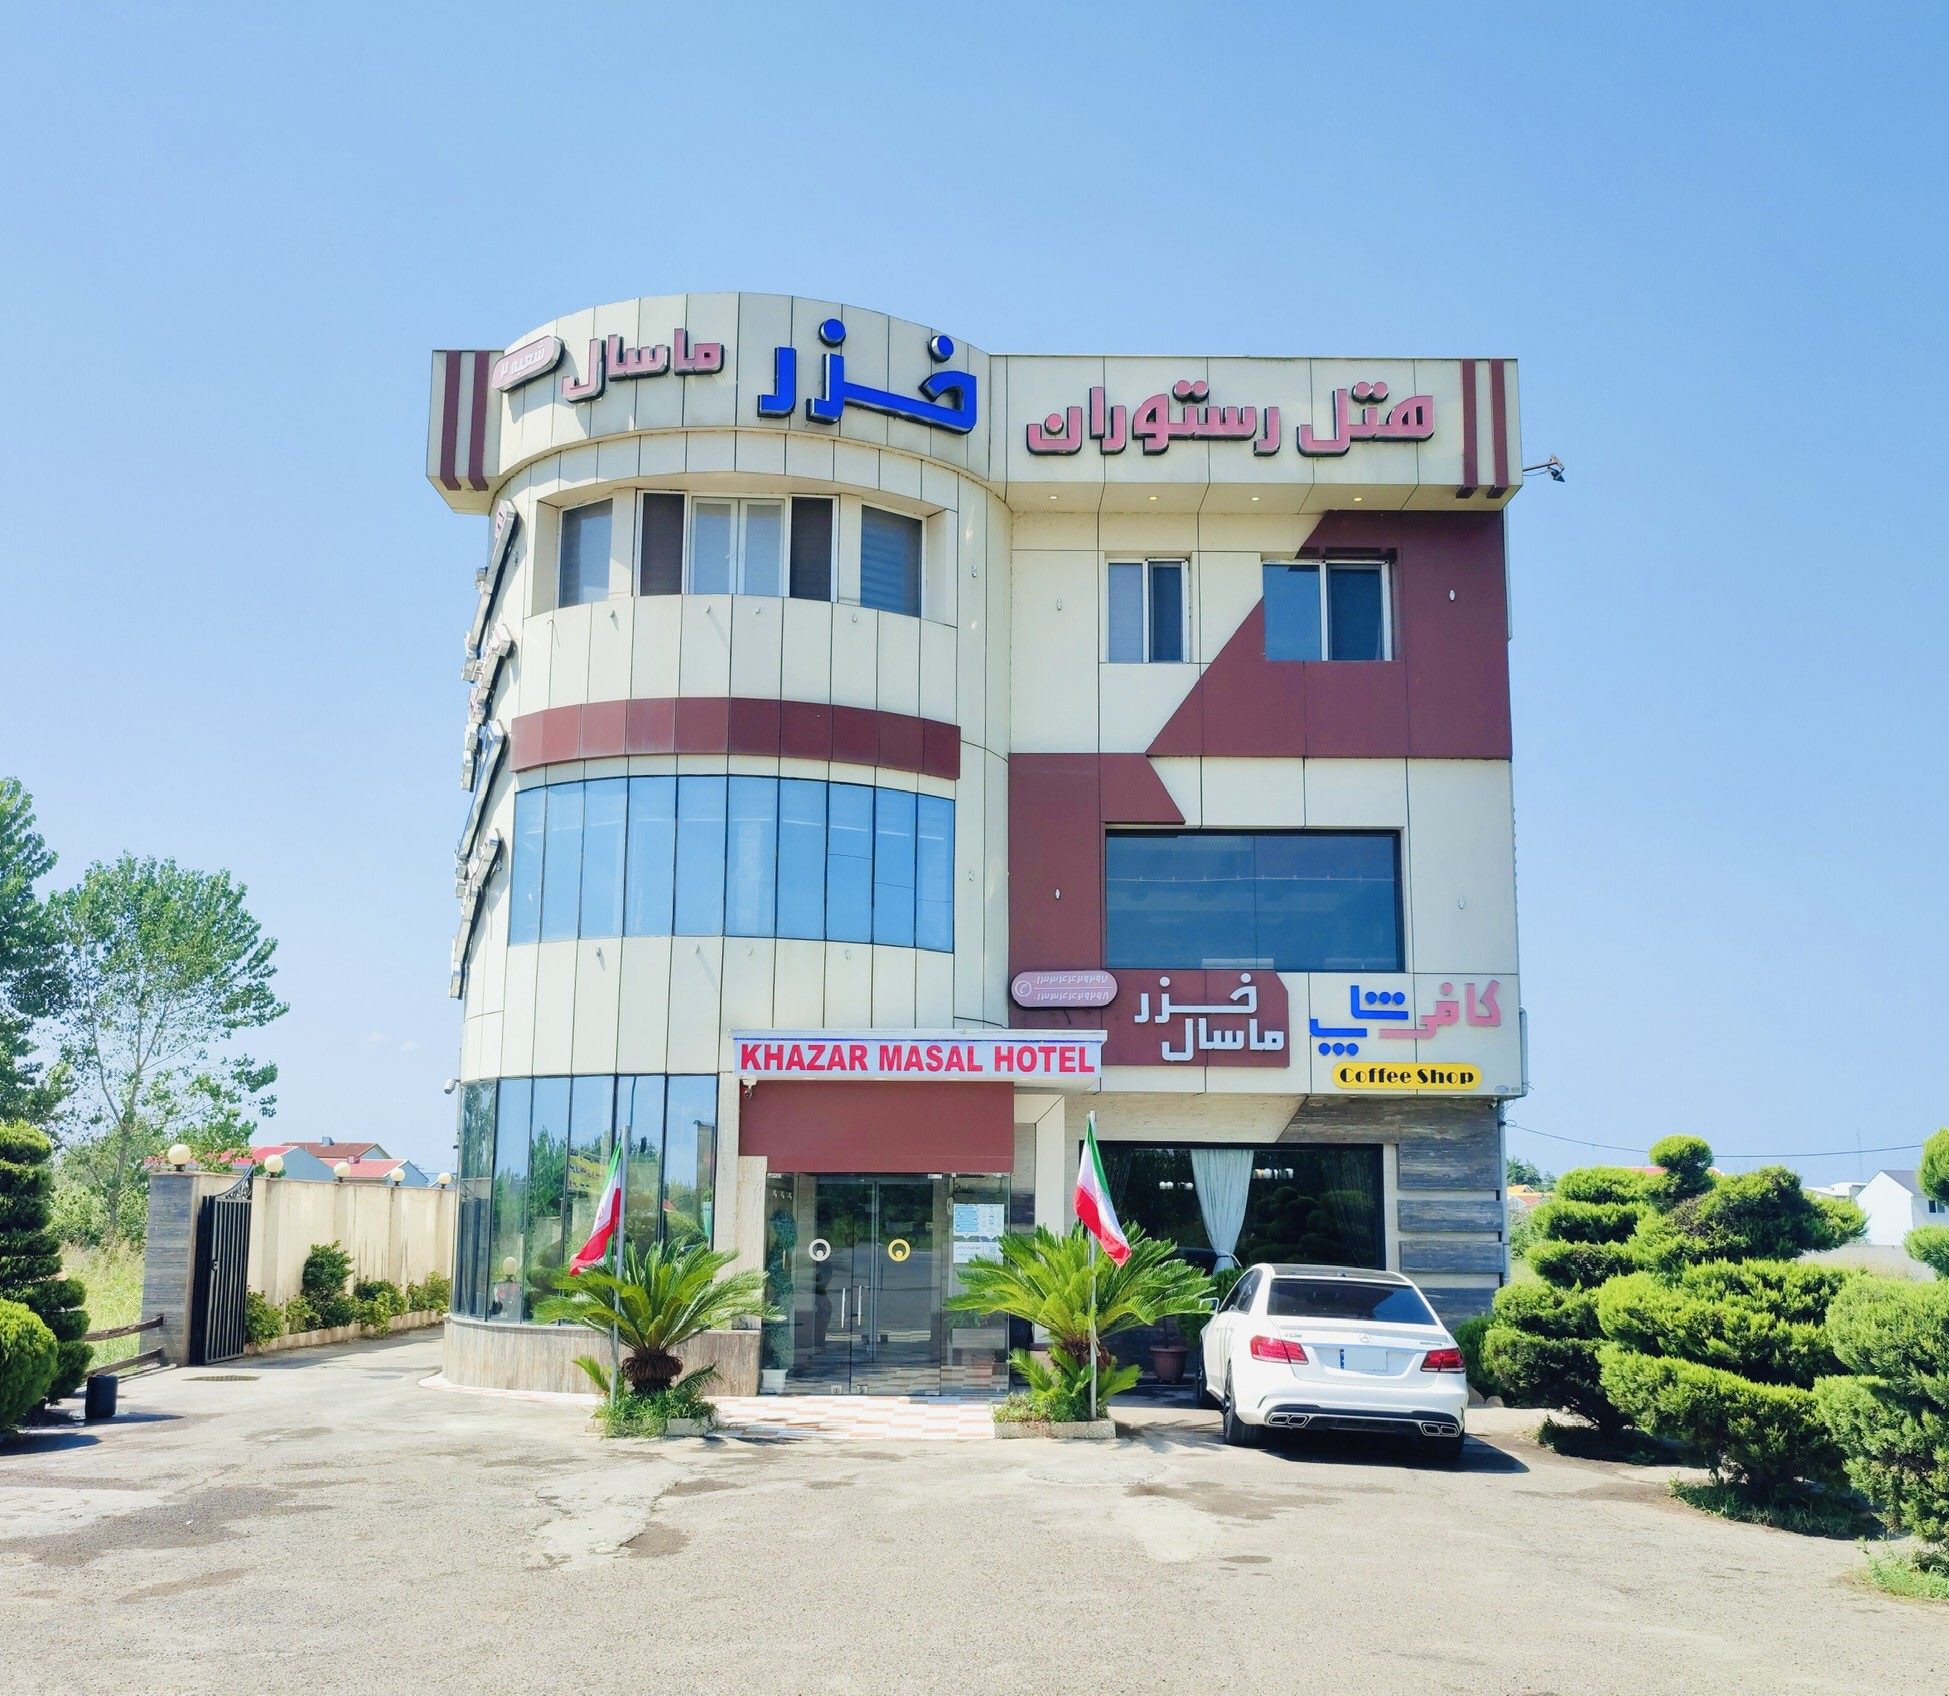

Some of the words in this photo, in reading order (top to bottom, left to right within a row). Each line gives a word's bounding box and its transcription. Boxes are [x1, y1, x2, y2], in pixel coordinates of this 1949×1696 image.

[511, 339, 547, 377] شعبه
[561, 328, 725, 403] ماسال
[757, 318, 979, 434] خزر
[1026, 380, 1281, 456] رستوران
[1296, 381, 1436, 457] هتل
[1134, 972, 1258, 1024] خزر
[1309, 985, 1409, 1057] شاپ
[1379, 979, 1501, 1040] کافی
[740, 1044, 869, 1071] KHAZAR
[879, 1045, 984, 1072] MASAL
[994, 1046, 1096, 1073] HOTEL
[1161, 1017, 1285, 1062] ماسال
[1339, 1068, 1412, 1084] Coffee
[1416, 1068, 1475, 1085] Shop
